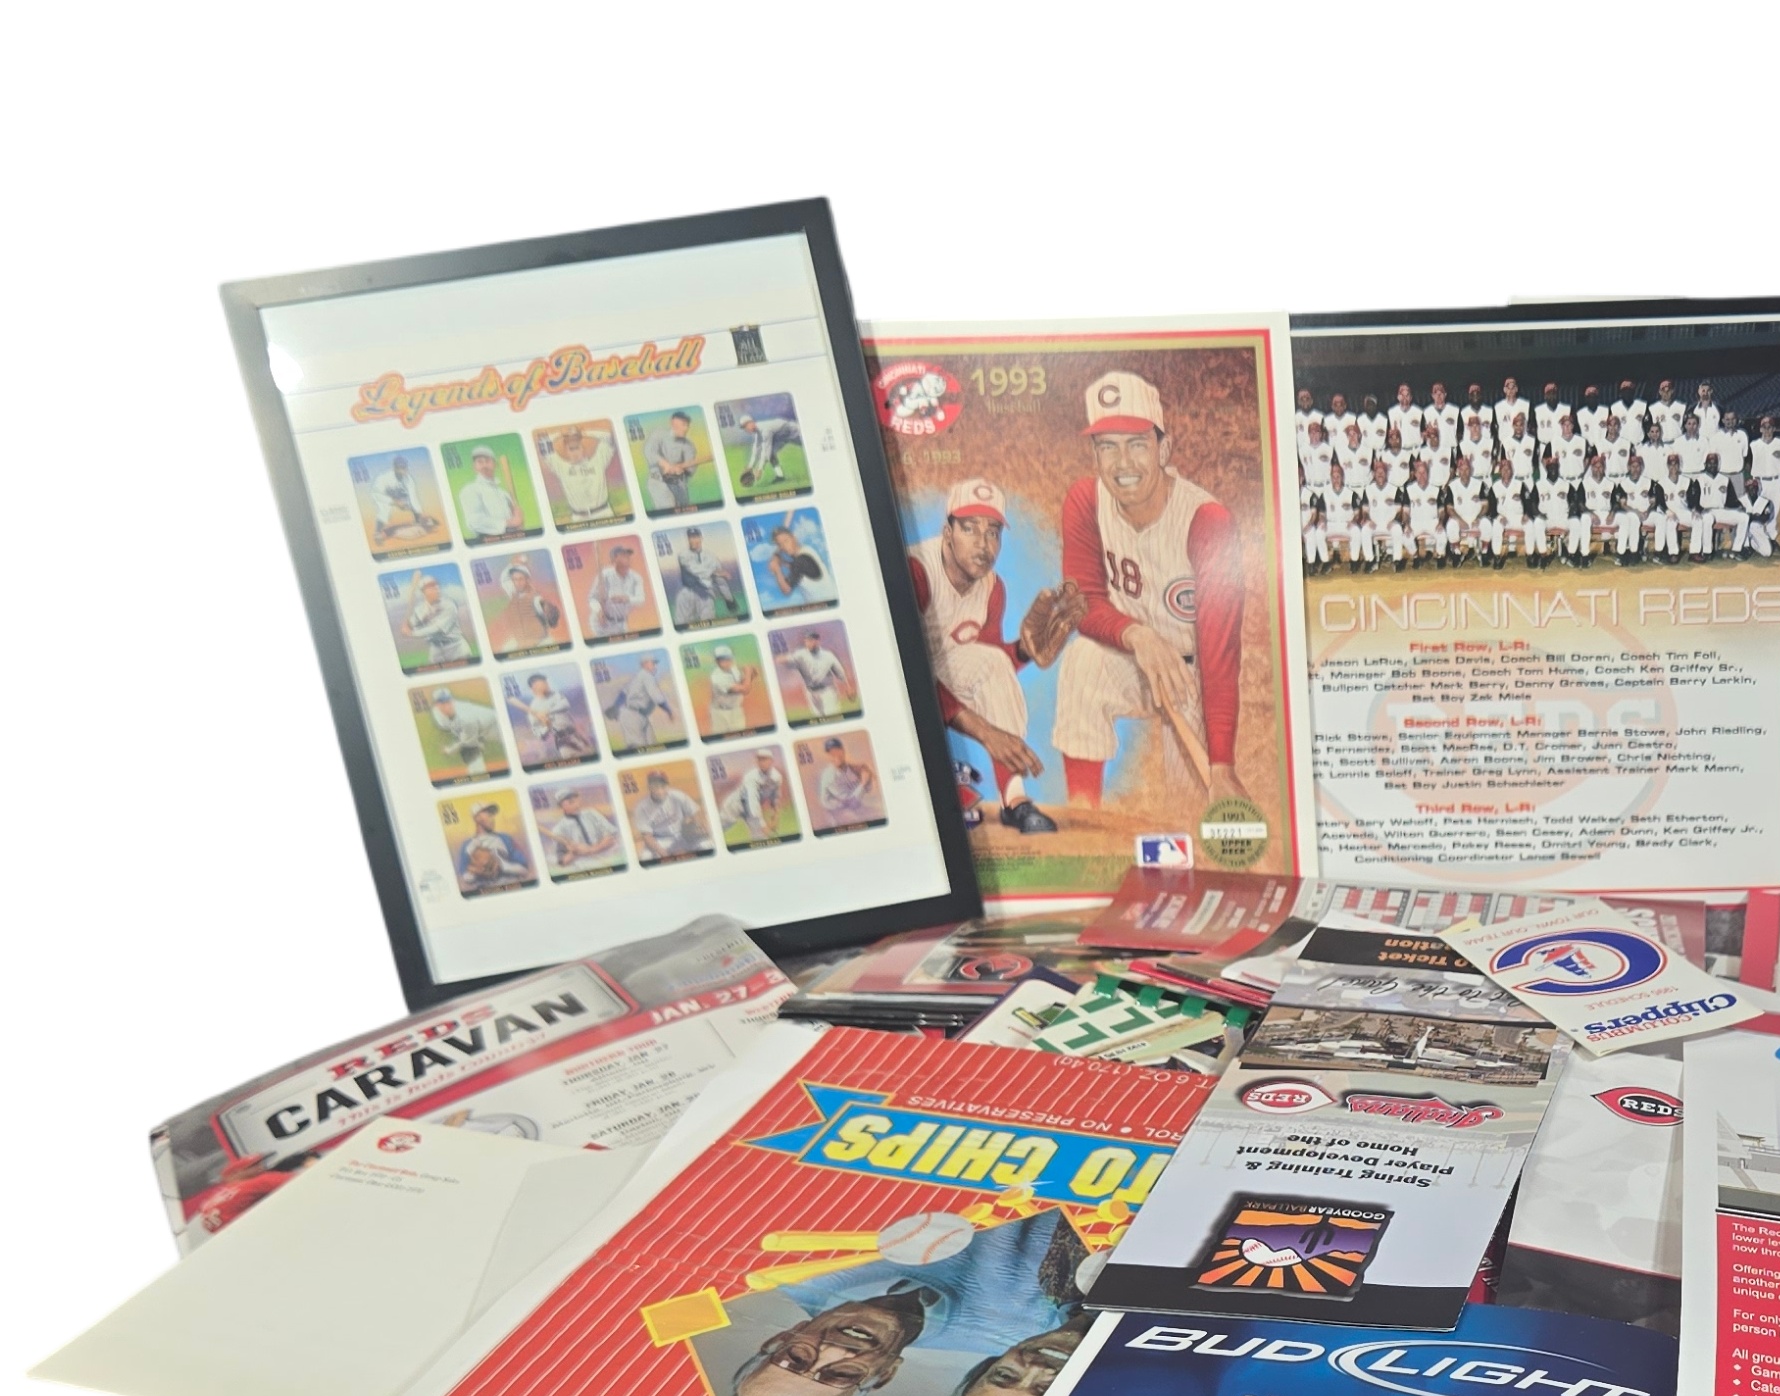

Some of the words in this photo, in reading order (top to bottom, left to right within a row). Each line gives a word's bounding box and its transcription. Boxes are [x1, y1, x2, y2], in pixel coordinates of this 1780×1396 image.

[357, 374, 501, 426] Legends
[505, 361, 546, 410] of
[548, 339, 703, 392] Baseball
[971, 367, 1047, 396] 1993
[1106, 551, 1143, 599] 18
[1319, 589, 1619, 633] CINCINNATI
[1410, 643, 1447, 652] First
[1454, 642, 1492, 652] Row,
[1641, 665, 1664, 673] Ken
[1670, 664, 1714, 674] Griffey
[1676, 728, 1706, 736] John
[1378, 951, 1448, 967] Ticket
[652, 999, 711, 1025] JAN.
[715, 986, 749, 1003] 27
[1584, 993, 1737, 1035] Clippers
[327, 1006, 497, 1079] REDS
[265, 992, 587, 1141] CARAVAN
[1247, 1091, 1310, 1103] REDS
[1621, 1097, 1683, 1119] REDS
[1286, 1134, 1322, 1146] the
[1326, 1137, 1350, 1148] of
[1357, 1140, 1418, 1157] Home
[822, 1115, 1060, 1188] CHIPS
[1236, 1145, 1378, 1167] Development
[1245, 1161, 1262, 1170] &
[1267, 1161, 1353, 1179] Training
[1384, 1158, 1454, 1176] Player
[1359, 1169, 1432, 1188] Spring
[1125, 1326, 1331, 1362] BUD
